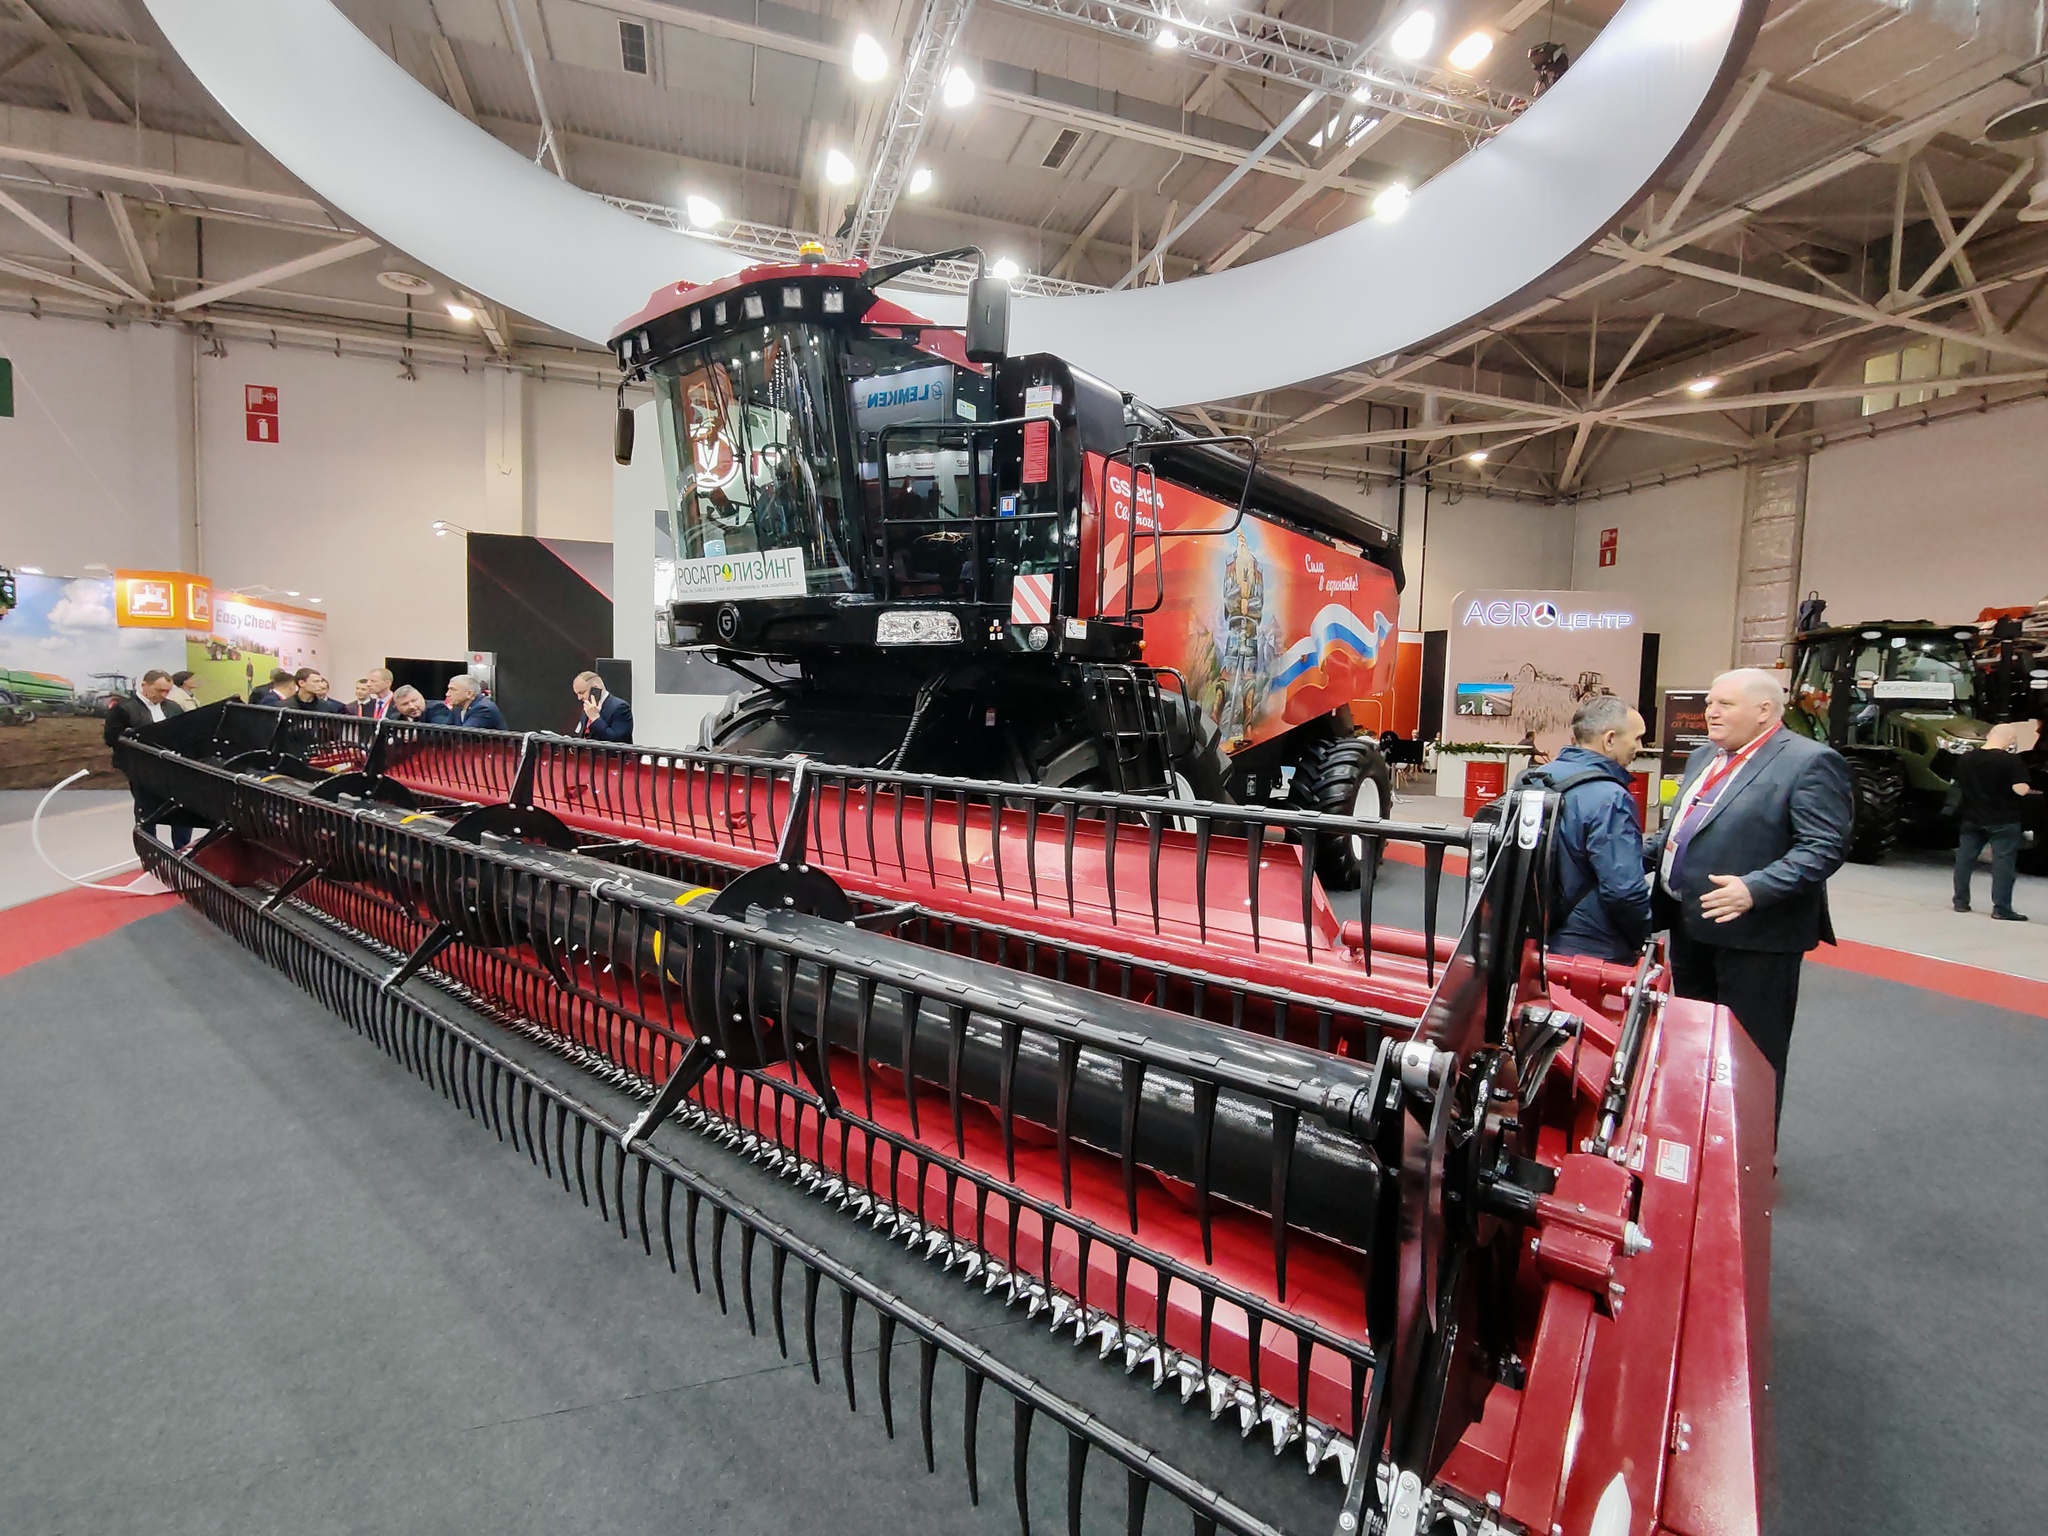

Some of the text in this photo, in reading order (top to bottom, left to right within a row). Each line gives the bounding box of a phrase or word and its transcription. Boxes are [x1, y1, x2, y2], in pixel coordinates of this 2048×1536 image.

[1109, 476, 1131, 498] GS
[677, 557, 796, 586] РОСАГРОЛИЗИНГ
[215, 609, 277, 631] EasyCheck
